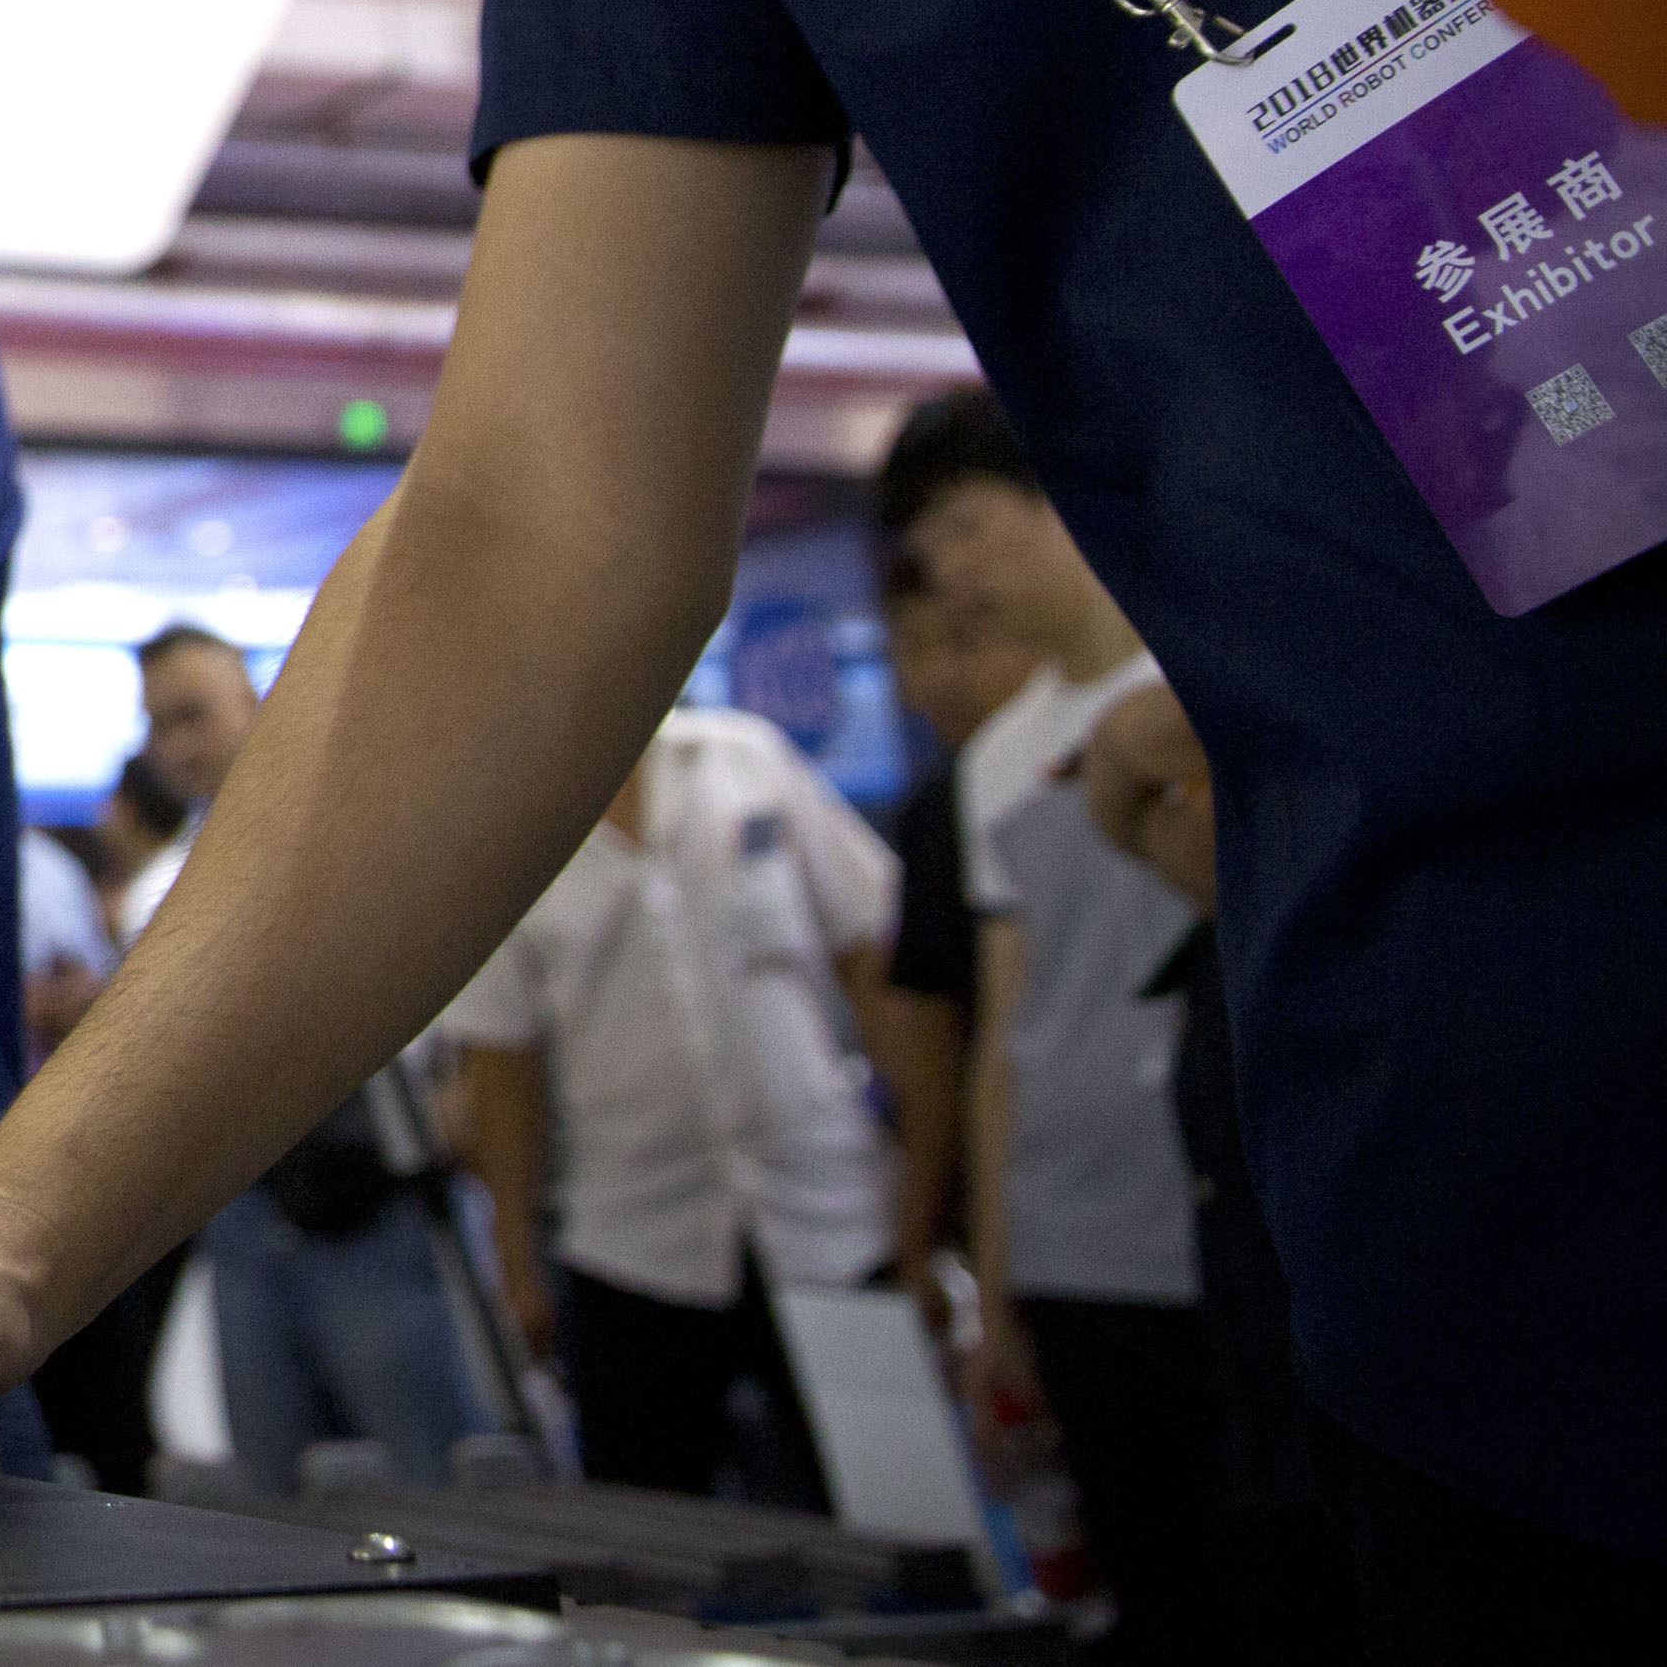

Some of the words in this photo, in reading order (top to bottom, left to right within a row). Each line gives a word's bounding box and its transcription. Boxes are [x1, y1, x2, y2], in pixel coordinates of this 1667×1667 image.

[1267, 102, 1339, 155] WORLD
[1338, 53, 1407, 108] ROBOT
[1415, 149, 1624, 304] 参展商
[1441, 214, 1655, 355] Exhibitor
